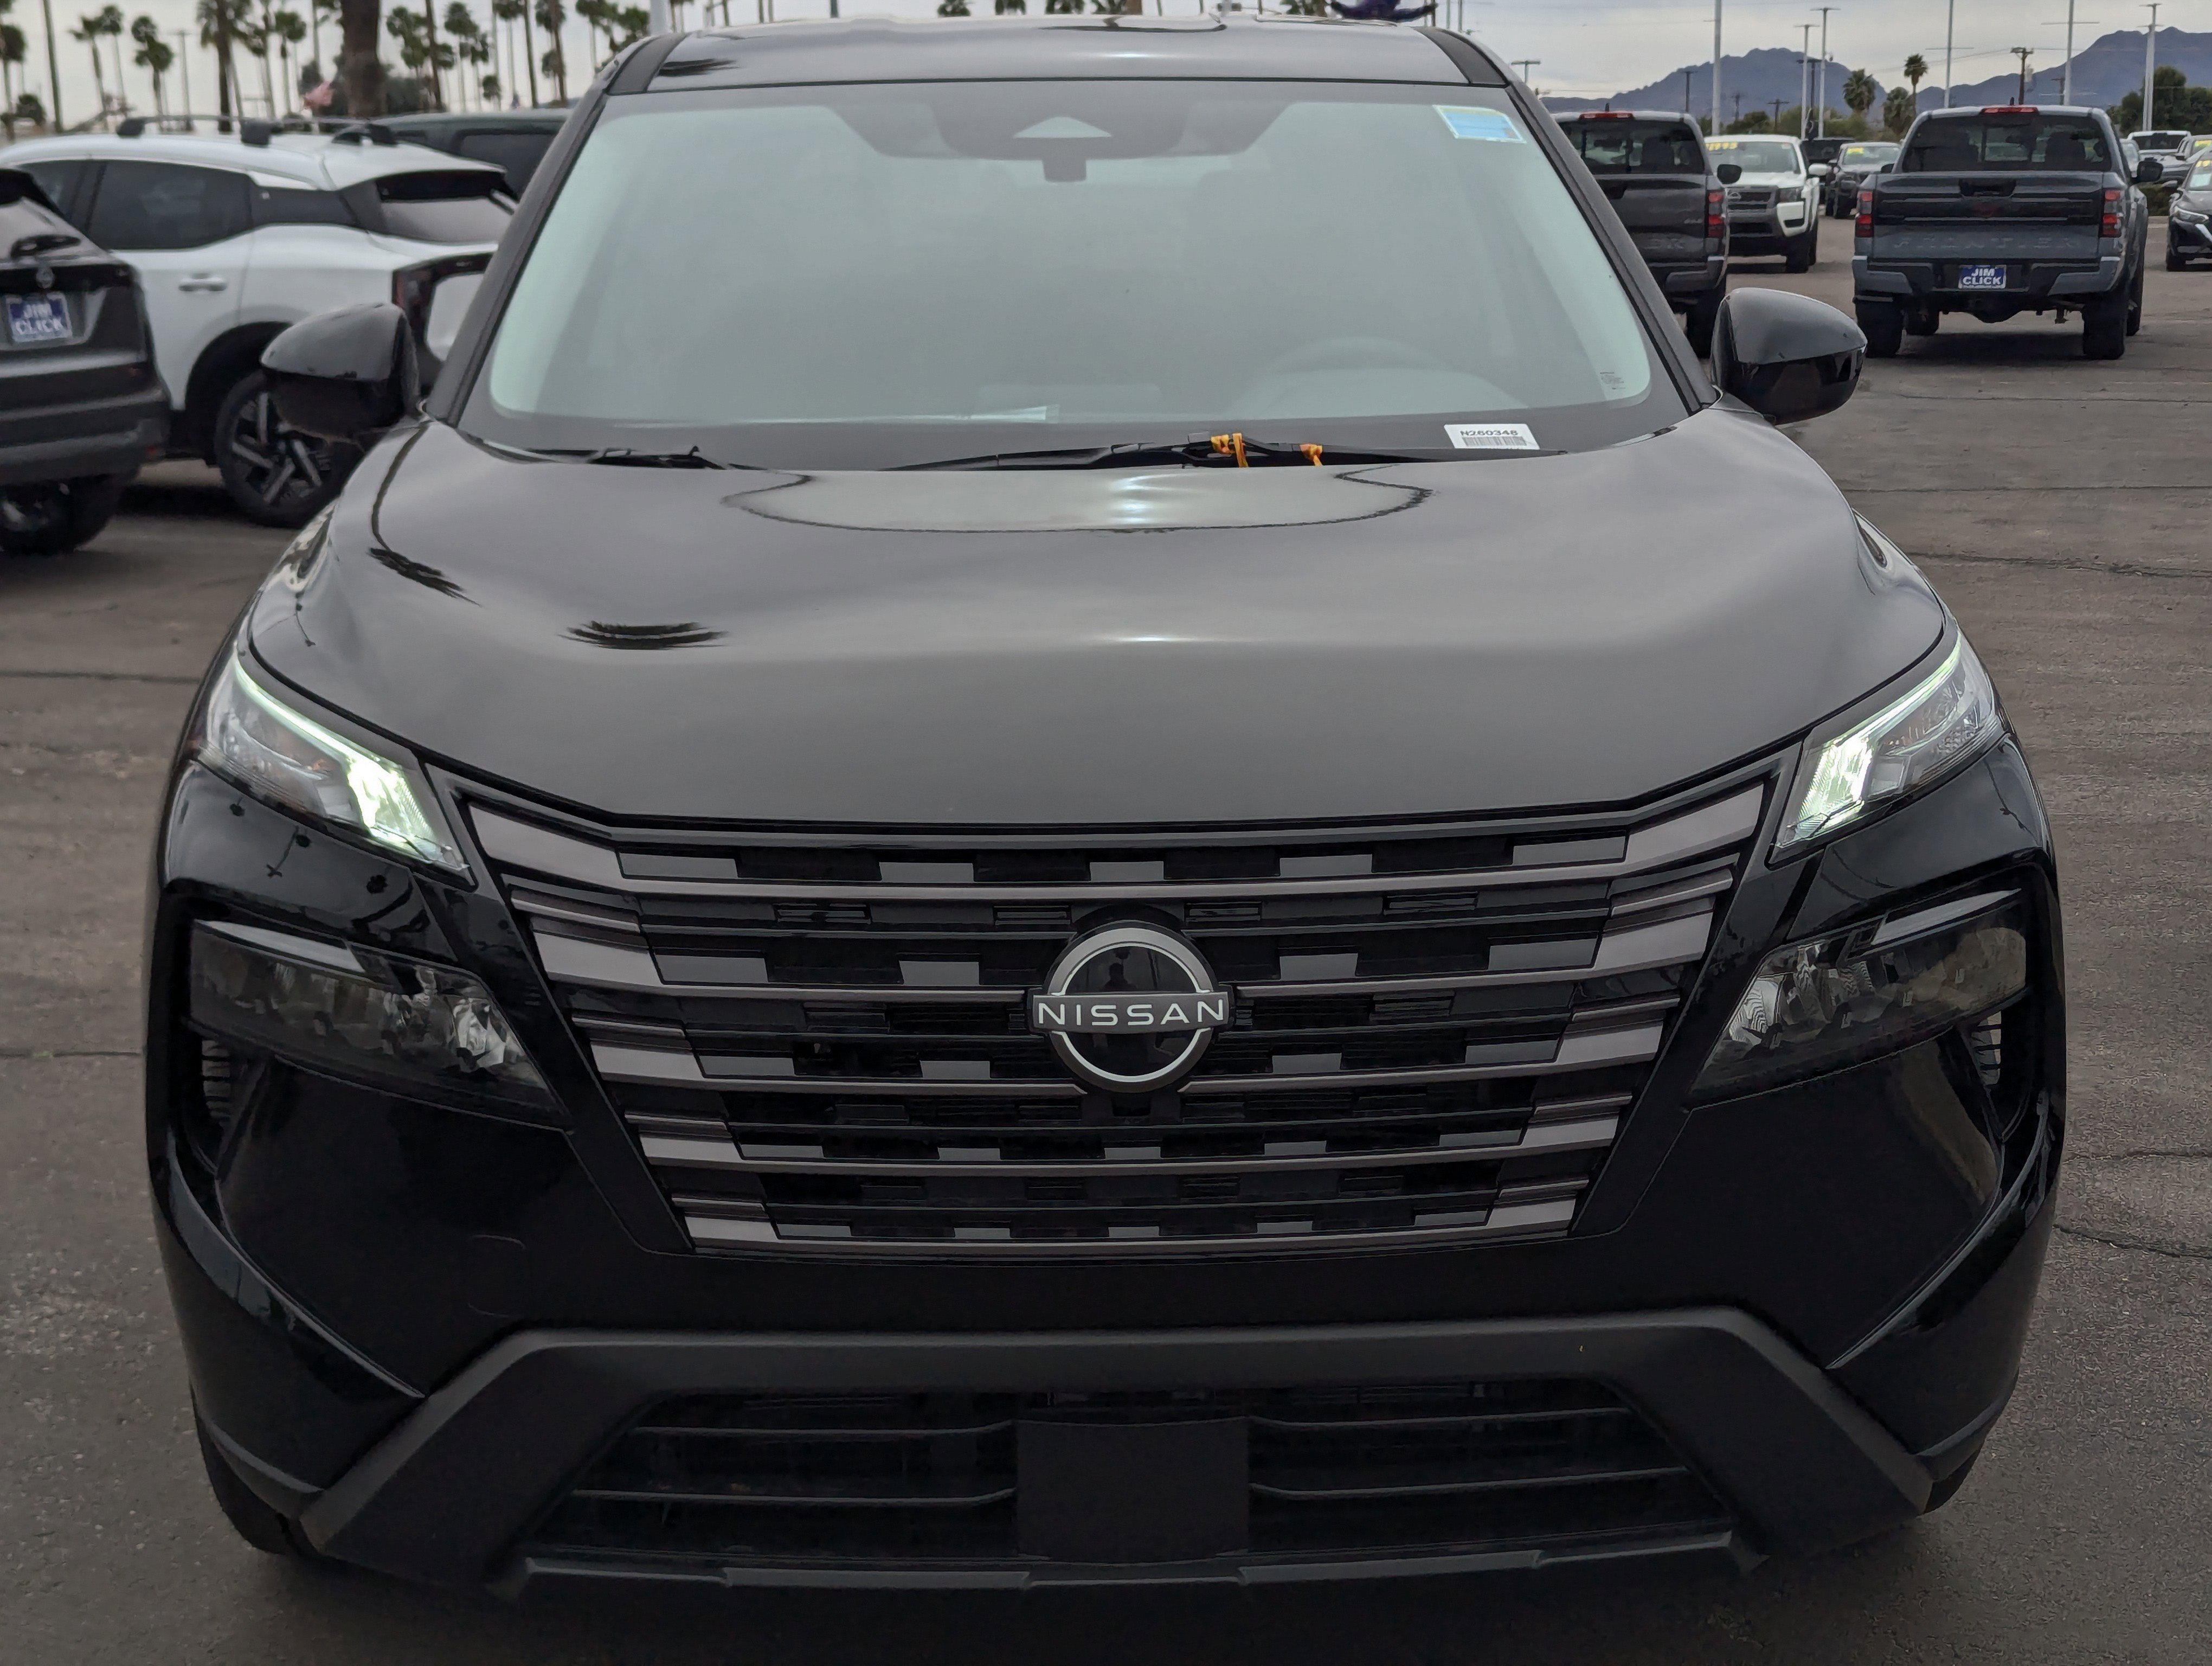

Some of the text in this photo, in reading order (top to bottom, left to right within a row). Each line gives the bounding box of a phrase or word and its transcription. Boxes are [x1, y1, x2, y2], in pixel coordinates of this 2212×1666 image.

[1971, 268, 1995, 277] JIM
[1963, 276, 2002, 285] CLICK
[23, 304, 53, 318] JIM
[15, 317, 64, 335] CLICK
[1038, 999, 1224, 1026] NISSAN
